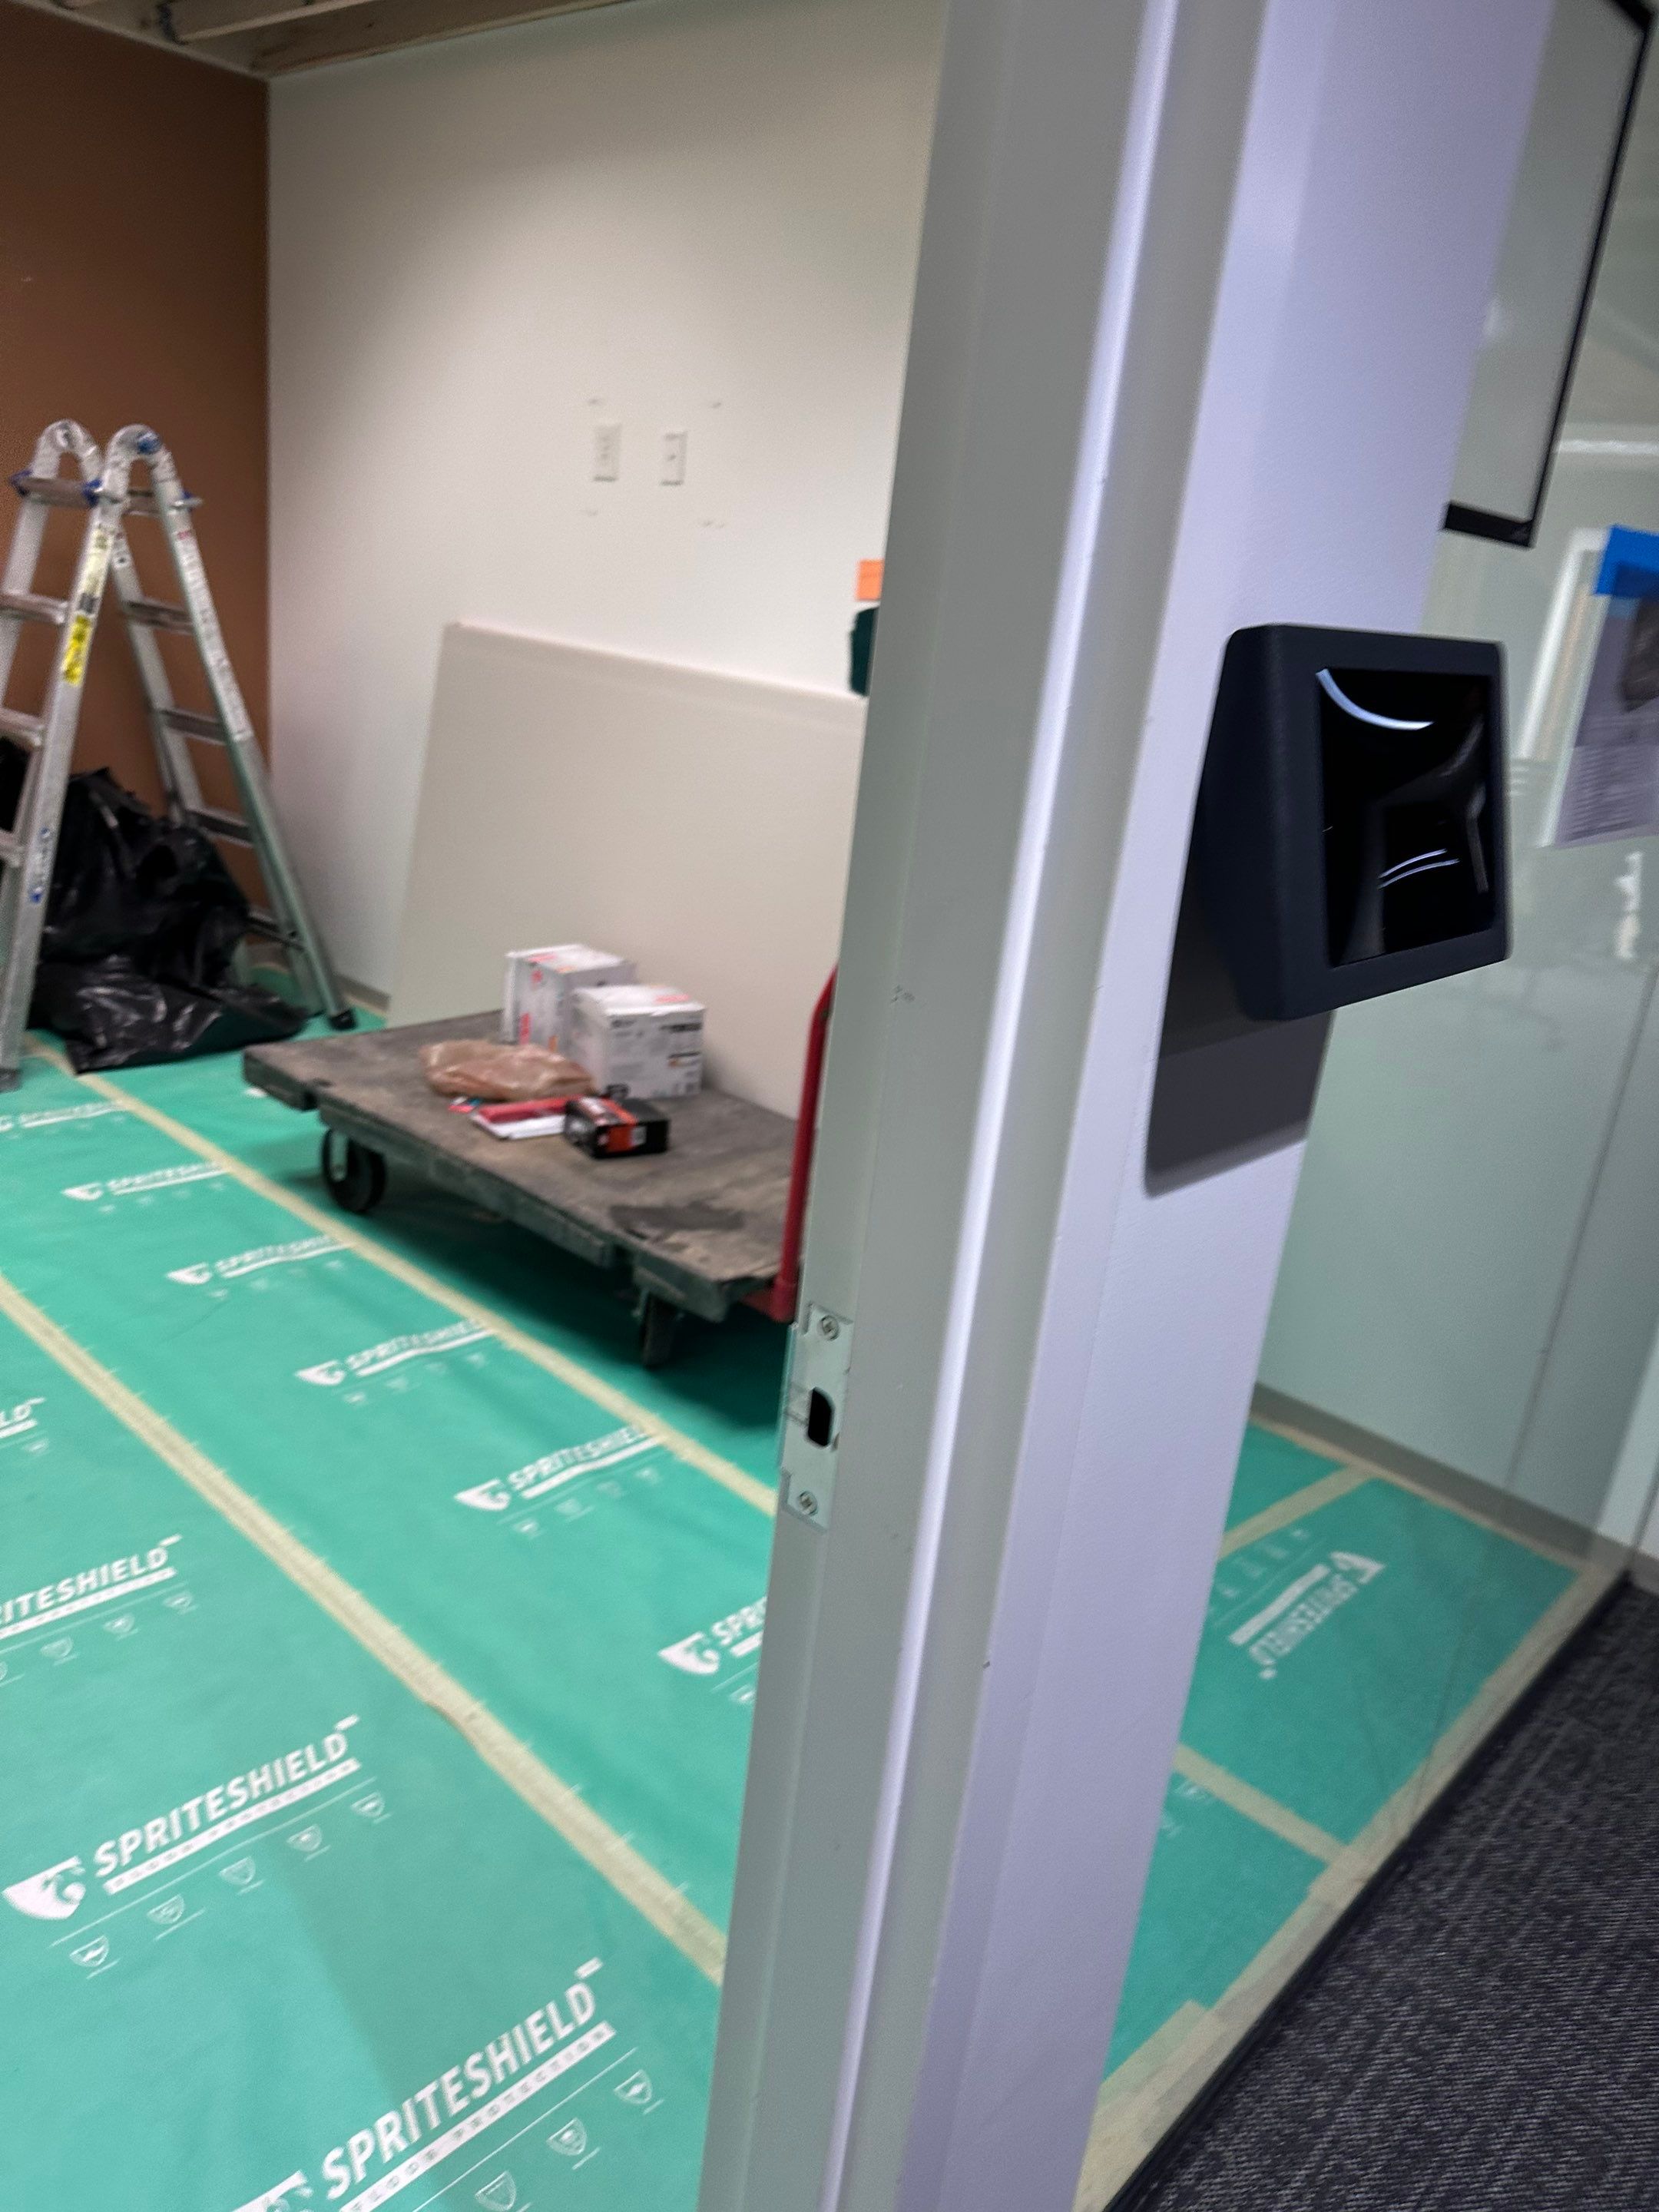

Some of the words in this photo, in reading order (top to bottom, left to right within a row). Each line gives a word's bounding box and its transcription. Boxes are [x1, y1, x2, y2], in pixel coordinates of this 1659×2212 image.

[0, 1546, 168, 1624] ITESHIELD
[93, 1731, 349, 1877] SPRITESHIELD
[321, 1982, 596, 2200] SPRITESHIELD
